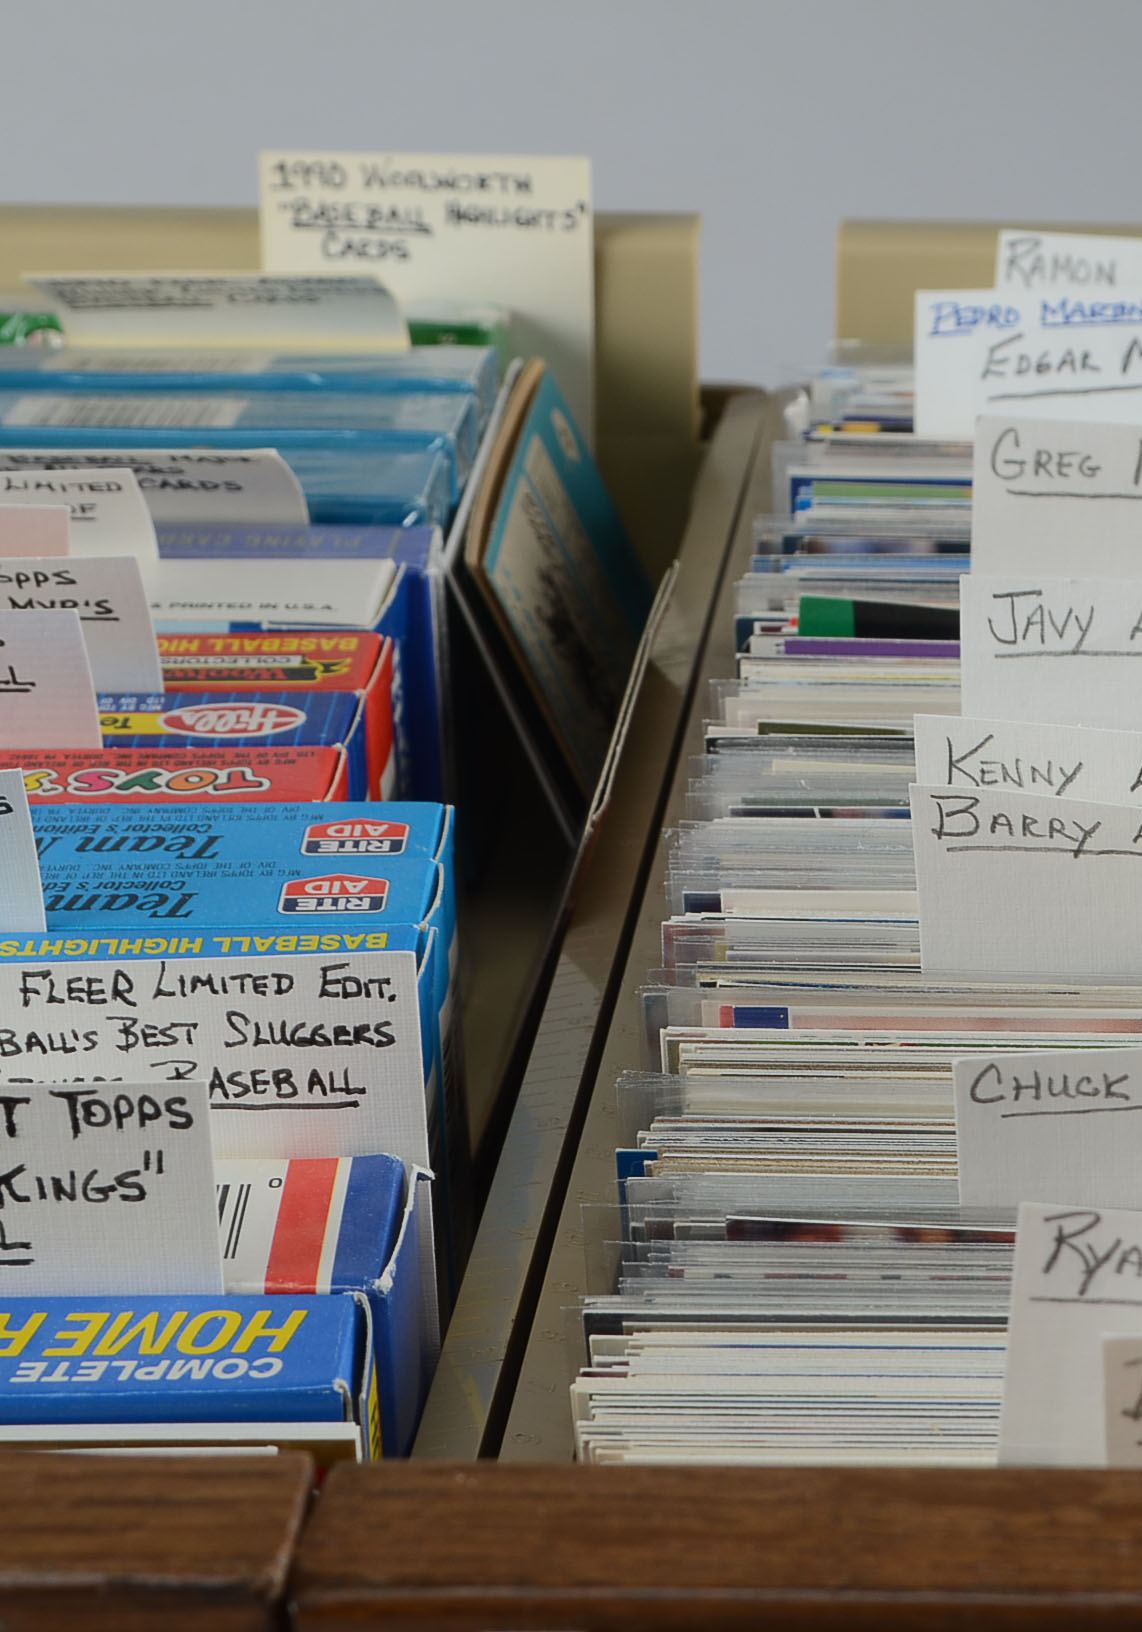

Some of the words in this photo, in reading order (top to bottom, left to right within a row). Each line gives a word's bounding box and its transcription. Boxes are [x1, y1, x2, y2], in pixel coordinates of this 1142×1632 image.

[272, 160, 347, 191] 1990
[321, 231, 412, 261] CARDS
[1004, 237, 1117, 289] RAMON
[929, 301, 1020, 331] PEDRO
[981, 333, 1101, 380] EDGAR
[991, 428, 1103, 483] GREG
[4, 476, 124, 492] LIMITED
[138, 477, 243, 490] CARDS
[988, 590, 1095, 653] JAVY
[208, 637, 359, 652] BASEBALL
[177, 704, 298, 733] Hills
[946, 734, 1083, 796] KENNY
[72, 769, 265, 790] TOYS
[105, 823, 213, 834] Collector's
[326, 823, 391, 836] AID
[930, 794, 1101, 858] BARRY
[74, 834, 224, 860] Team
[317, 840, 392, 853] RITE
[77, 880, 187, 892] Collector's
[304, 880, 369, 894] AID
[45, 892, 199, 918] Team
[295, 897, 371, 911] RITE
[0, 937, 203, 956] HIGHLIGHTS
[213, 932, 389, 952] BASEBALL
[20, 970, 137, 1007] FLEER
[153, 961, 294, 999] LIMITED
[319, 962, 398, 1002] EDIT.
[106, 1016, 199, 1053] BEST
[224, 1010, 397, 1048] SLUGGERS
[970, 1063, 1131, 1105] CHUCK
[49, 1088, 194, 1139] TOPPS
[41, 1309, 309, 1356] HOME
[9, 1357, 284, 1383] COMPLETE
